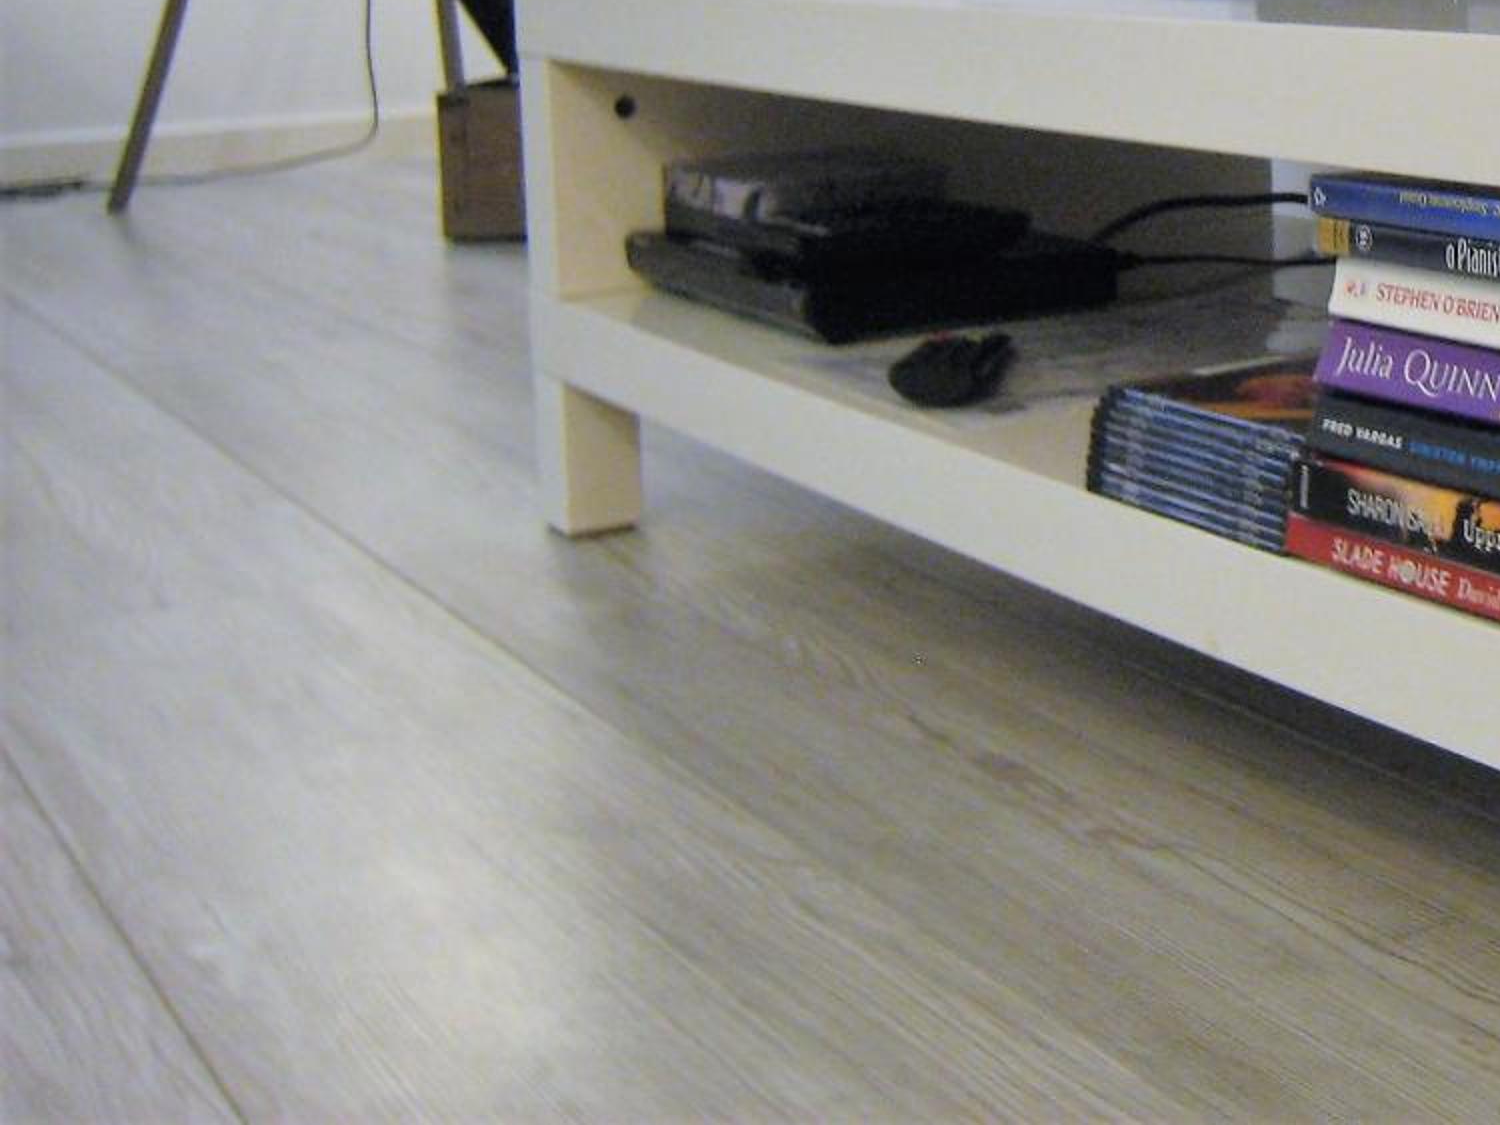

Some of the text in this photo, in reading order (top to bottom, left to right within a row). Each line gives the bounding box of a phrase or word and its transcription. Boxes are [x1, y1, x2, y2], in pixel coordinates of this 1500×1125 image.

[1377, 283, 1440, 311] STEPHEN
[1336, 336, 1394, 380] Julia
[1322, 418, 1403, 450] FRED VARGAS
[1346, 488, 1406, 529] SHARON
[1332, 538, 1385, 574] SLADE
[1388, 554, 1450, 596] HOUSE
